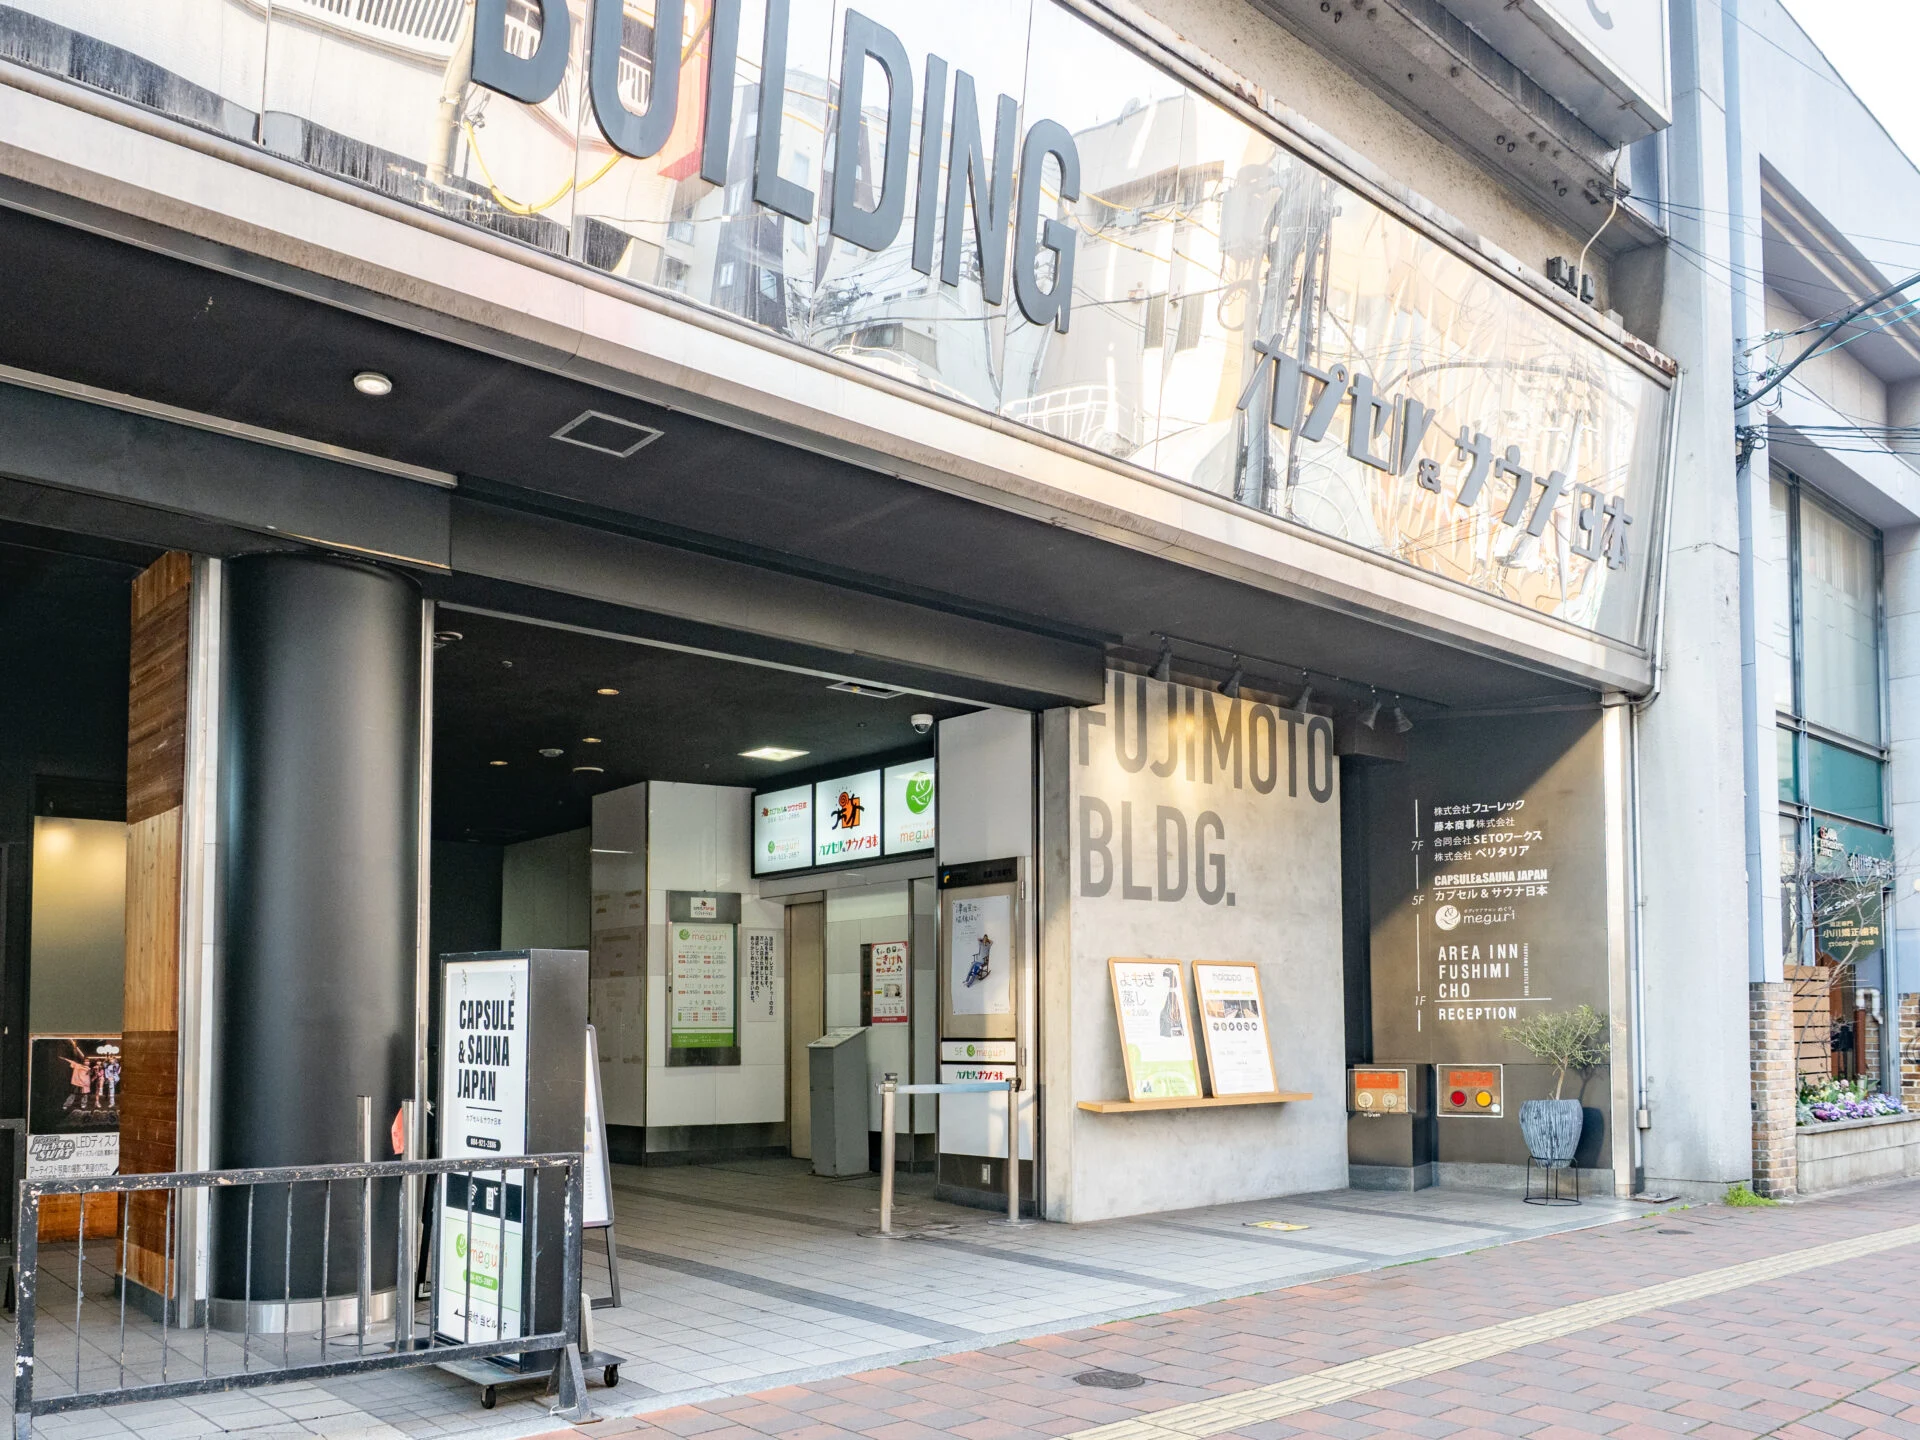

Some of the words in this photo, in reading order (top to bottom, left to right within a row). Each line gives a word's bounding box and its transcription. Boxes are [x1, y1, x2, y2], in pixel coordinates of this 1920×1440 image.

[1079, 795, 1236, 907] BLDG.
[1411, 840, 1424, 852] 7F
[1434, 871, 1515, 886] CAPSULE&SAUNA
[1516, 869, 1548, 881] JAPAN
[1411, 895, 1425, 906] 5F
[1463, 910, 1515, 925] meguri
[1438, 945, 1481, 961] AREA
[1489, 943, 1518, 959] INN
[1438, 962, 1510, 980] FUSHIMI
[1438, 982, 1470, 998] CHO
[1415, 995, 1427, 1006] 1F
[459, 1000, 515, 1031] CAPSULE
[1438, 1006, 1517, 1021] RECEPTION
[458, 1039, 466, 1064] &
[467, 1034, 510, 1067] SAUNA
[976, 1047, 1006, 1059] meguri
[457, 1068, 497, 1102] JAPAN
[470, 1248, 508, 1269] megui
